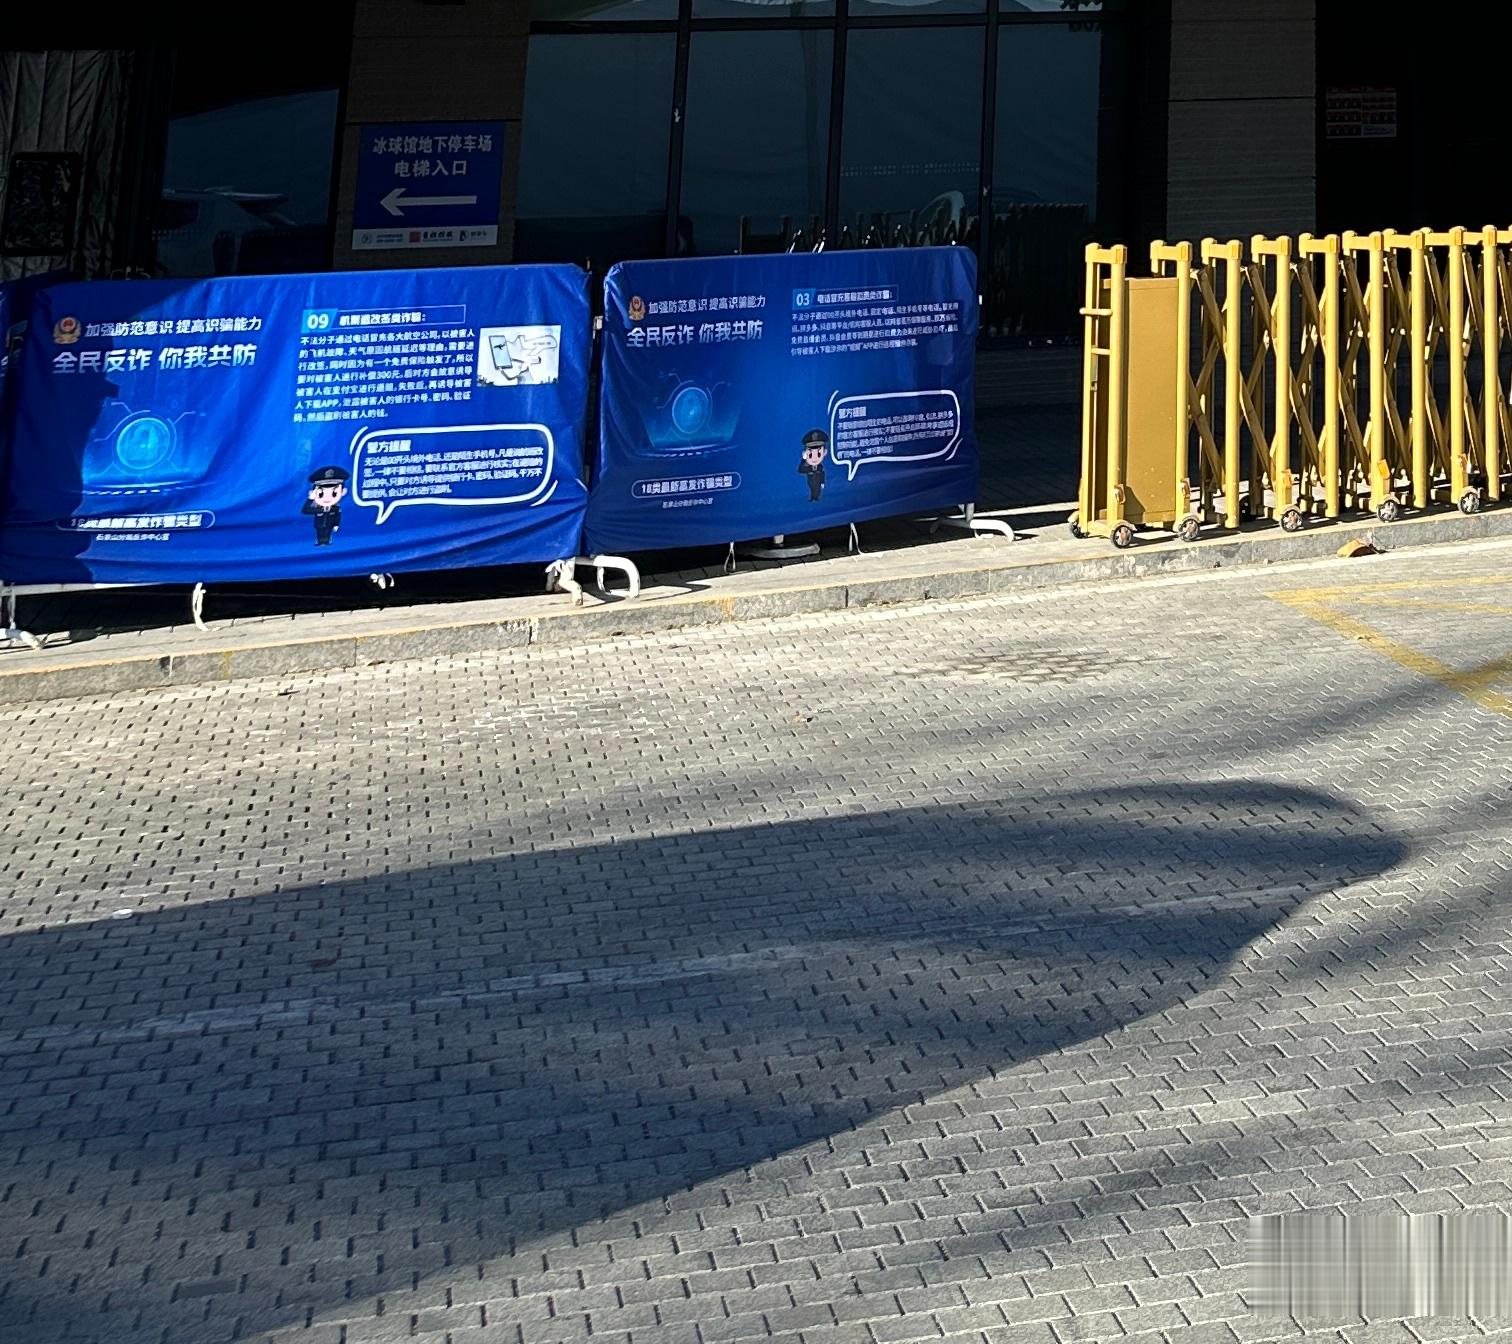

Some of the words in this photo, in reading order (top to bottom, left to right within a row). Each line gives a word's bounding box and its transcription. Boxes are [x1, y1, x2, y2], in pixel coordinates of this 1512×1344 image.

[372, 134, 493, 154] 冰球馆地下停车场
[394, 159, 468, 178] 电梯入口
[648, 298, 709, 315] 加强防范意识
[796, 293, 810, 306] 03
[85, 320, 174, 338] 加强防范意识
[175, 316, 263, 335] 提高识骗能力
[307, 314, 329, 329] 09
[626, 325, 694, 348] 全民反诈
[698, 320, 764, 344] 你我共防
[52, 348, 152, 374] 全民反诈
[158, 343, 258, 370] 你我共防
